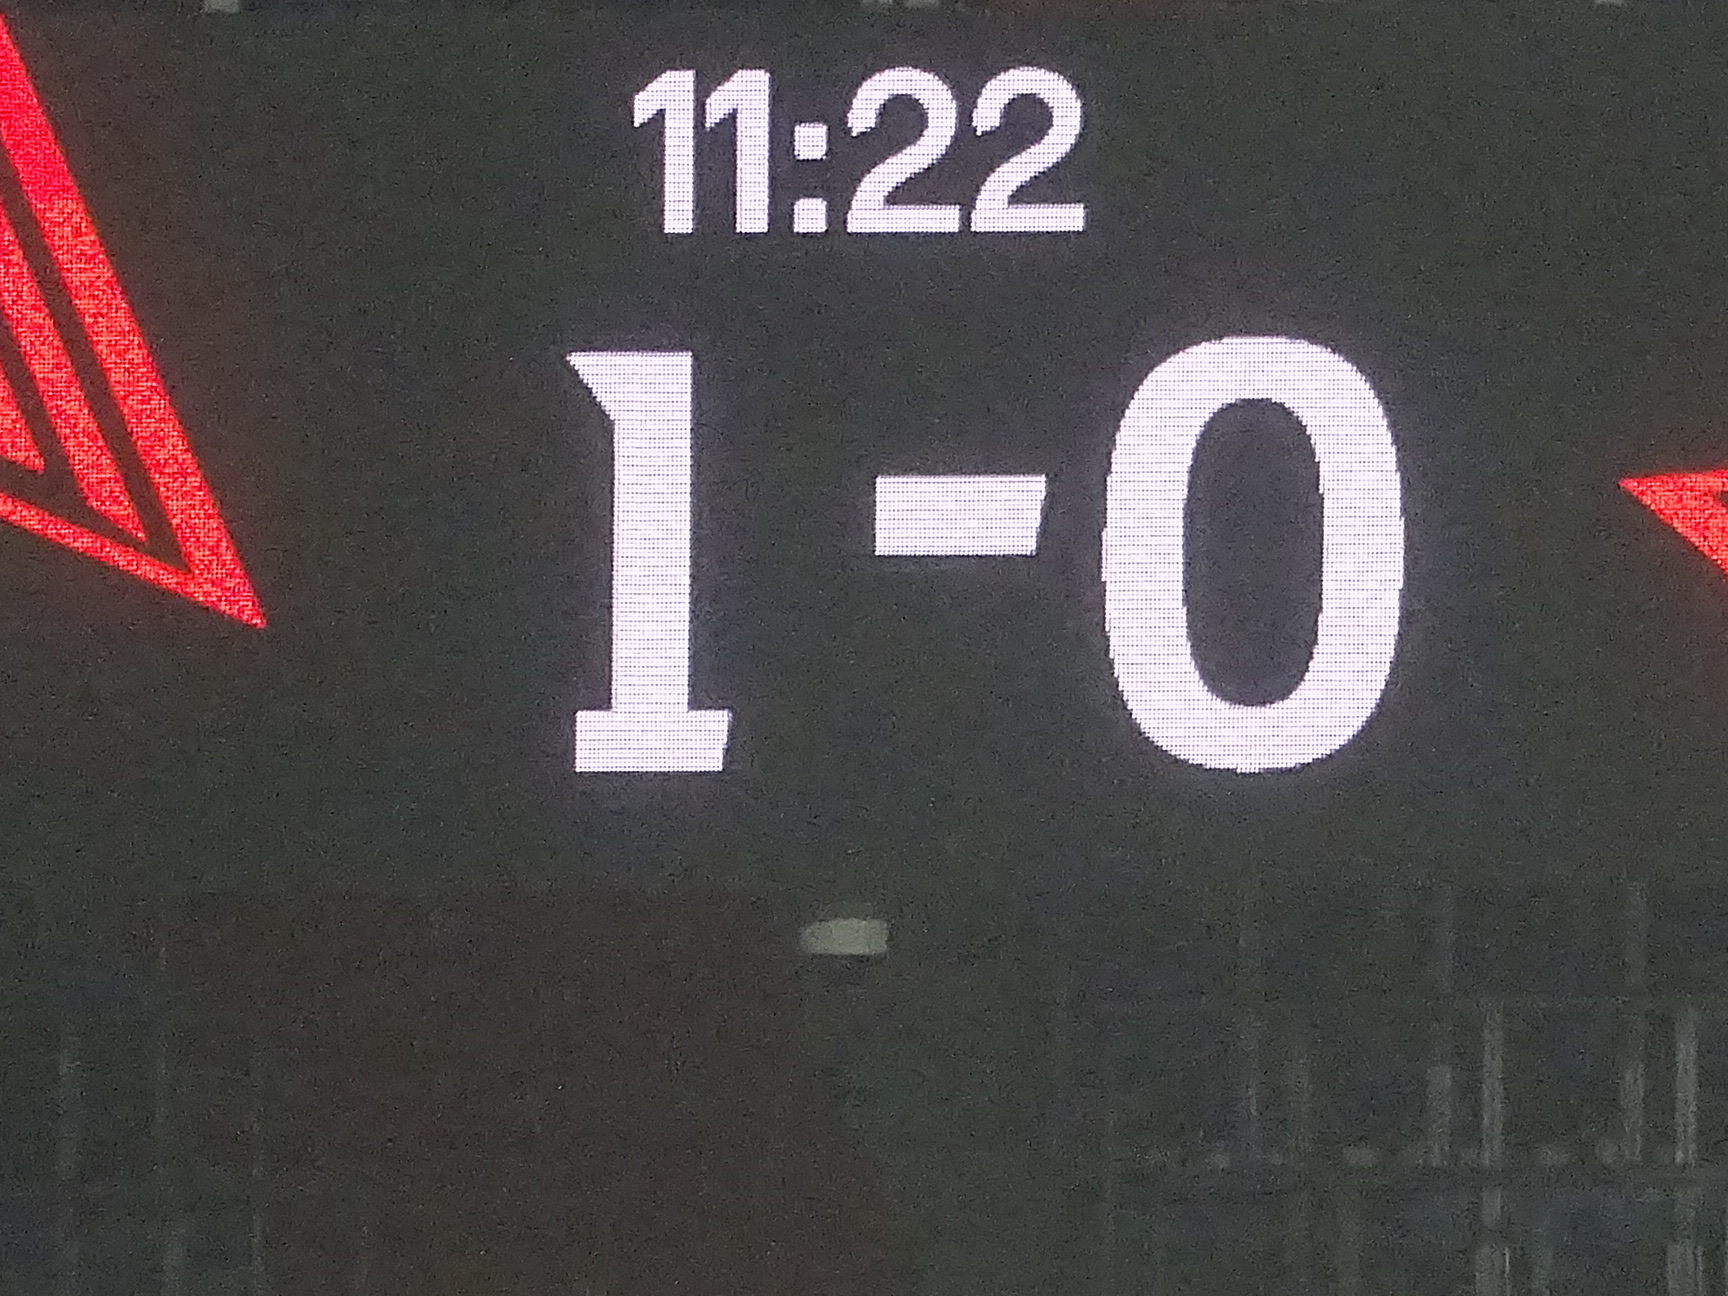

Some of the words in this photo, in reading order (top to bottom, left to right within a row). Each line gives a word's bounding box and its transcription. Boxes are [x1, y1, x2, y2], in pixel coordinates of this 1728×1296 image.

[632, 66, 1086, 234] 11:22
[566, 350, 732, 772] 1
[1101, 335, 1405, 773] 0
